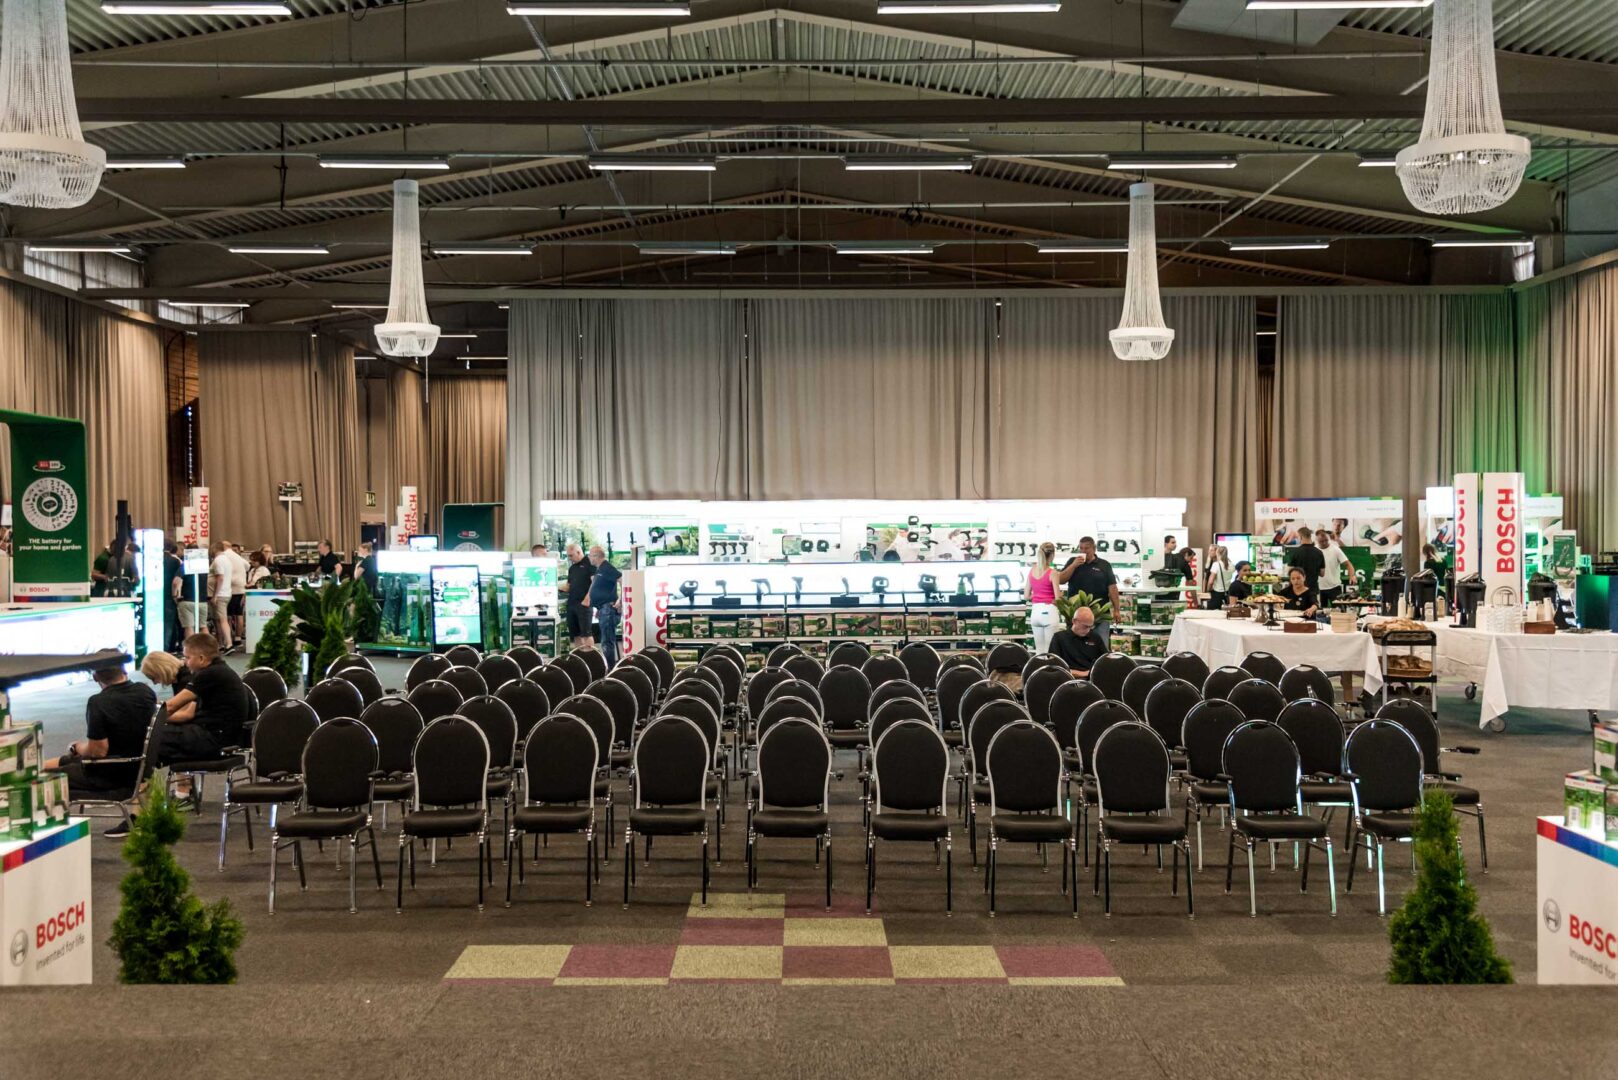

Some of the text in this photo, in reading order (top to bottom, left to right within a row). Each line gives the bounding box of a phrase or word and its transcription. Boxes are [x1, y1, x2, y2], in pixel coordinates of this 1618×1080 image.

[200, 494, 209, 538] BOSCH
[1496, 488, 1515, 573] BOSCH
[655, 582, 669, 649] OSCH
[36, 900, 85, 950] BOSCH
[1569, 914, 1617, 959] BOSC
